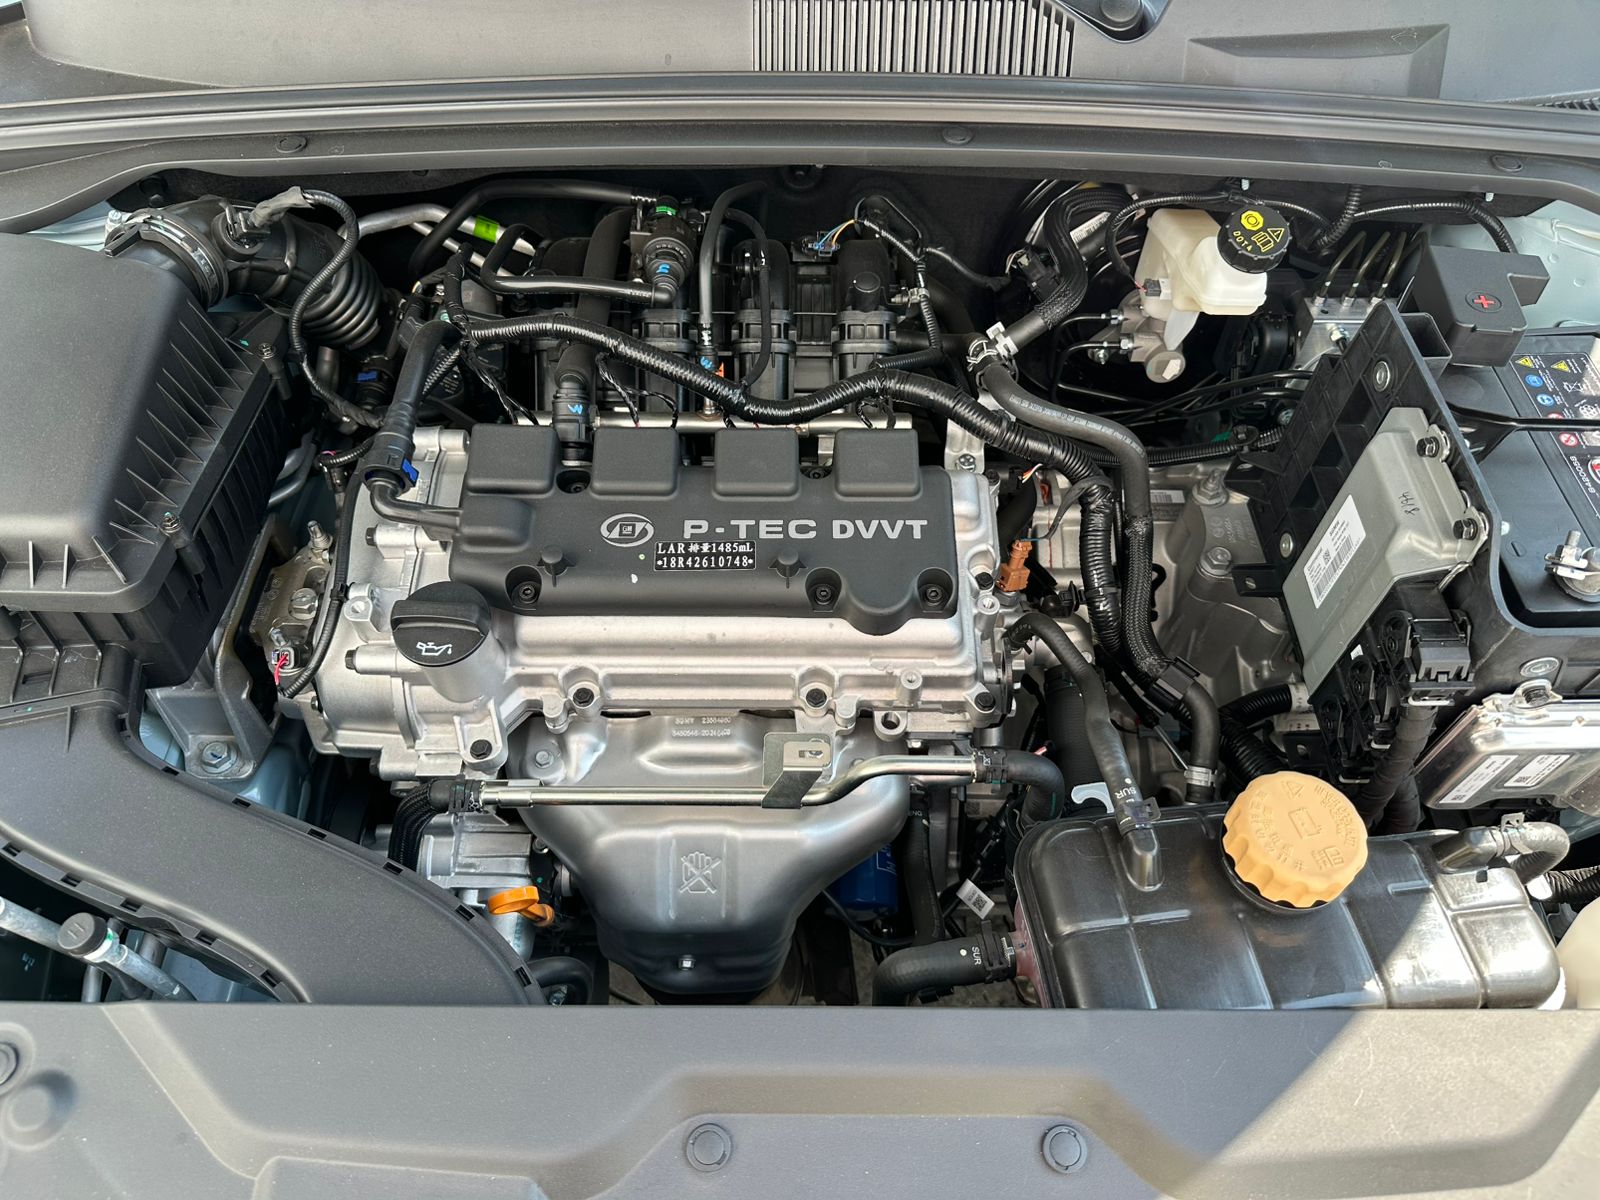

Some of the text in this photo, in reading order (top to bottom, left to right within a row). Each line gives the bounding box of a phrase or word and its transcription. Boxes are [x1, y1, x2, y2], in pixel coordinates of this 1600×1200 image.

[1233, 230, 1253, 252] DOT4
[683, 519, 928, 539] P-TEC DVVT
[657, 542, 686, 554] LAR
[1114, 786, 1137, 799] SUR
[971, 946, 982, 965] SUR
